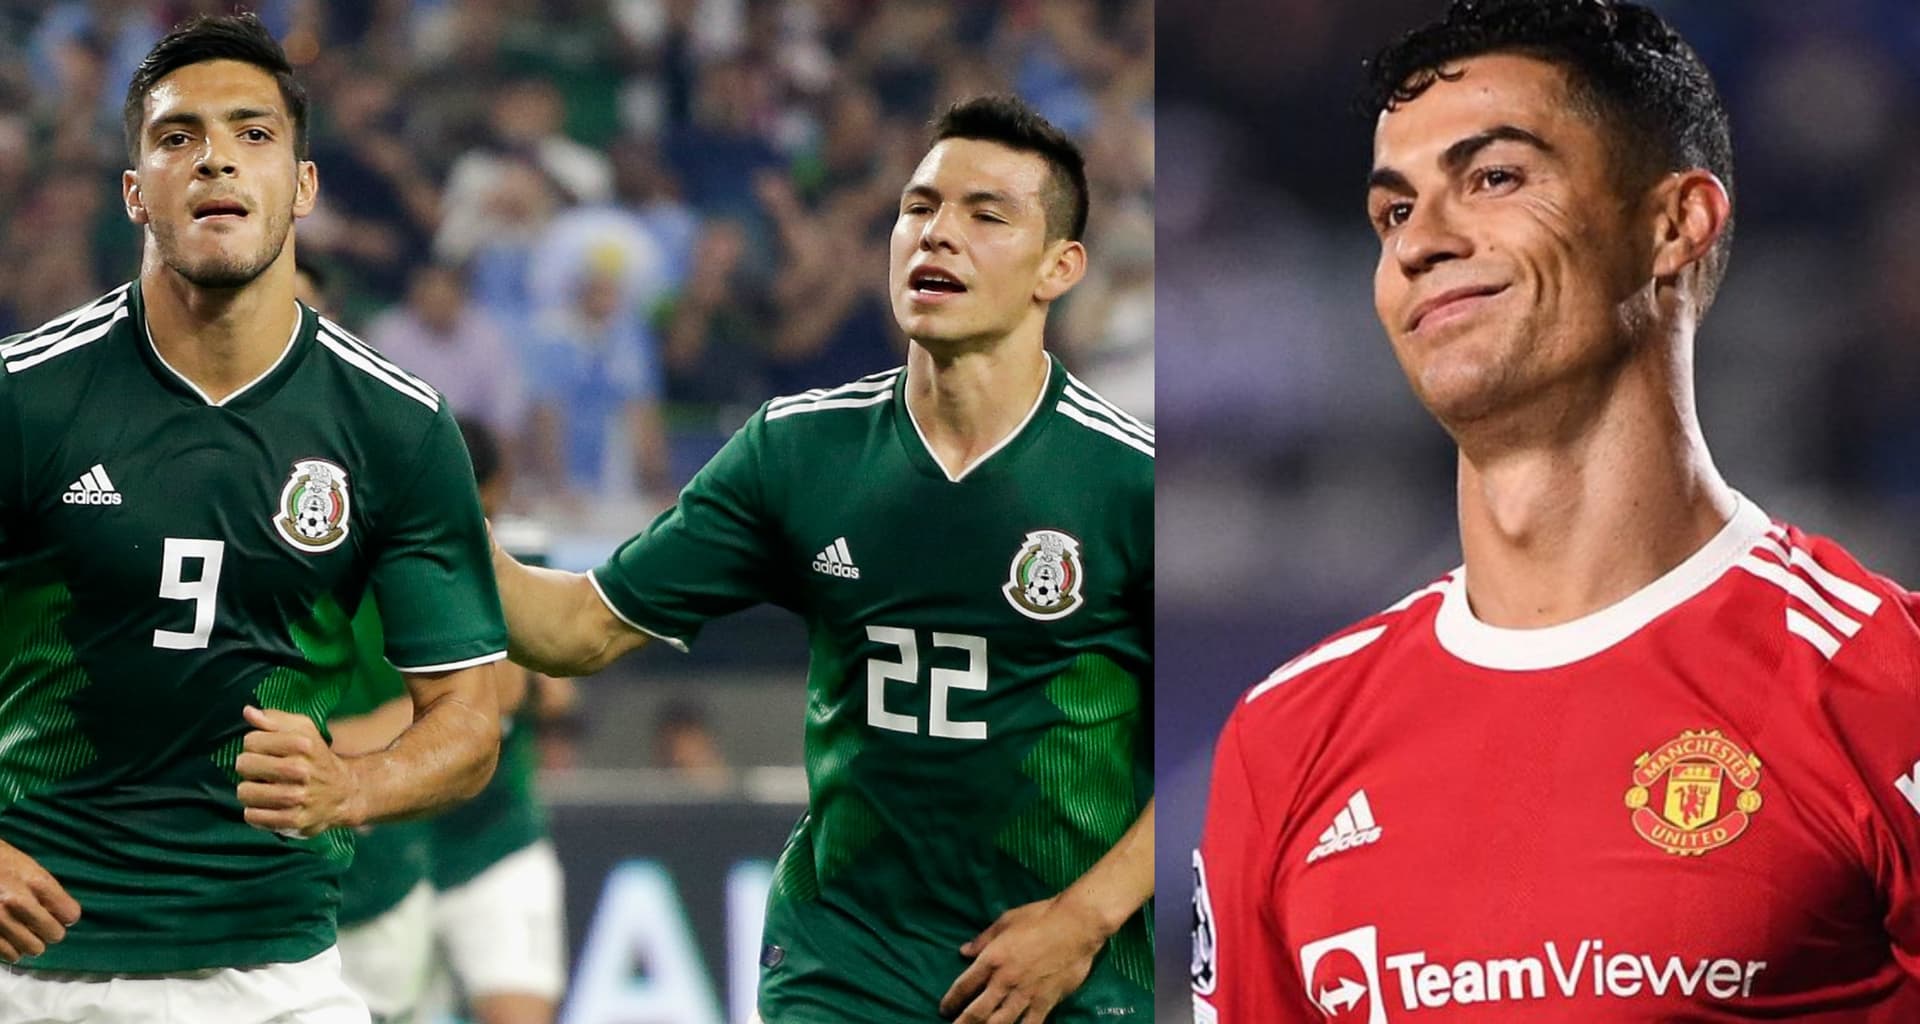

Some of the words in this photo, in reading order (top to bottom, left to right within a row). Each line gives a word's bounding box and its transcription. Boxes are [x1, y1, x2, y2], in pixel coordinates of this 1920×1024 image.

[62, 489, 122, 505] adidas
[812, 560, 860, 579] adidas
[153, 538, 224, 649] 9
[866, 625, 988, 740] 22
[1644, 740, 1751, 780] MANCHESTER
[1651, 824, 1727, 846] UNITED
[1385, 940, 1767, 1011] TeamViewer
